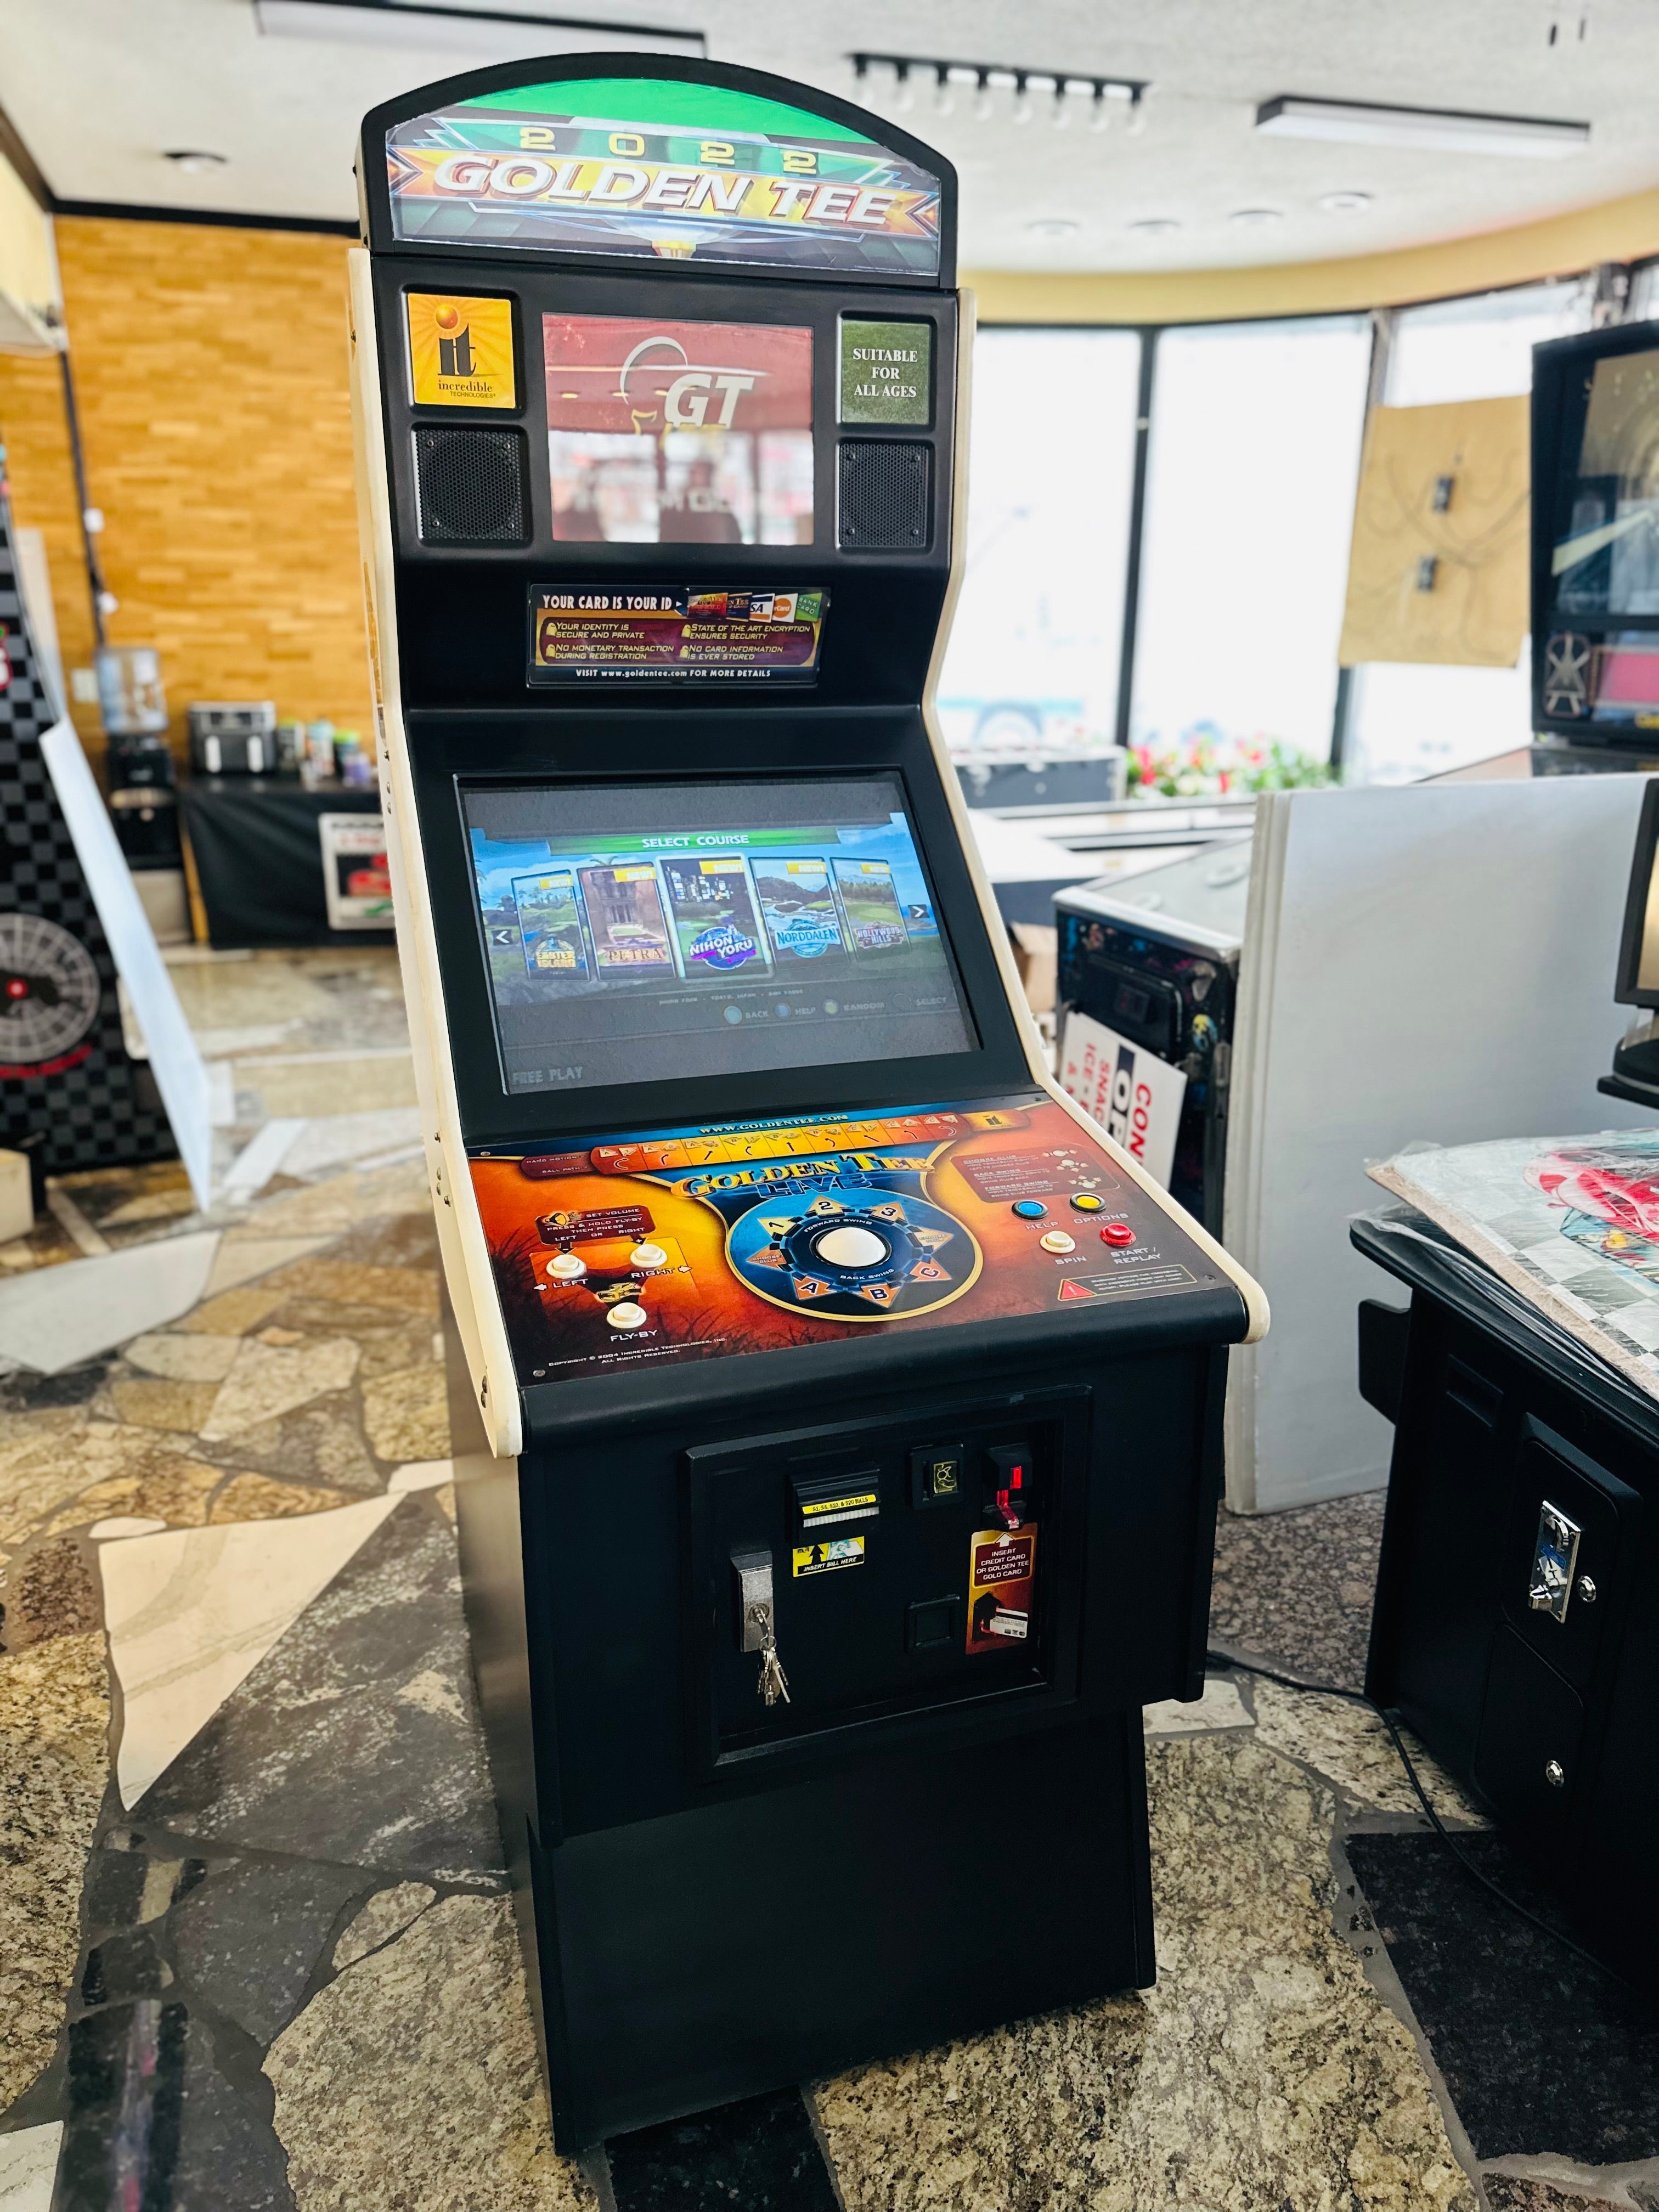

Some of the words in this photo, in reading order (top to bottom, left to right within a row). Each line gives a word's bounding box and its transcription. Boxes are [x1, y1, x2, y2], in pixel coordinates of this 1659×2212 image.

[435, 154, 753, 212] GOLDEN
[768, 180, 897, 225] TEE
[853, 348, 917, 363] SUITABLE
[872, 366, 899, 380] FOR
[439, 380, 493, 392] incredible
[854, 383, 878, 397] ALL
[882, 384, 916, 398] AGES
[664, 373, 755, 428] GT
[543, 595, 574, 609] YOUR
[578, 596, 608, 609] CARD
[613, 596, 622, 610] IS
[627, 596, 657, 610] YOUR
[661, 597, 672, 610] ID
[750, 603, 763, 613] SA
[799, 597, 818, 607] BANK
[797, 603, 816, 614] CARD
[556, 622, 579, 630] YOUR
[601, 669, 687, 678] www.goldentee.com
[641, 837, 690, 848] SELECT
[696, 835, 749, 845] COURSE
[777, 927, 838, 945] NORDDALEN
[857, 927, 900, 938] HOLLYWOOD
[690, 935, 732, 956] NIHON
[871, 935, 891, 944] HILLS
[717, 939, 753, 958] YORU
[608, 948, 664, 962] PETRA
[513, 1070, 543, 1084] FREE
[549, 1066, 582, 1081] PLAY
[1094, 1059, 1109, 1123] SNAC
[699, 1115, 849, 1133] WWW.GOLDENTEE.COM
[1130, 1083, 1152, 1159] CON
[670, 1159, 841, 1198] GOLDEN
[841, 1153, 935, 1172] TEE
[757, 1173, 873, 1198] LIVE
[819, 1200, 833, 1211] 2
[881, 1206, 896, 1217] 3
[1074, 1213, 1128, 1224] OPTIONS
[768, 1221, 785, 1229] 1
[804, 1218, 840, 1233] FORWARD
[1111, 1248, 1148, 1257] START
[1055, 1256, 1087, 1265] SPIN
[1114, 1254, 1161, 1265] REPLAY
[631, 1267, 675, 1278] RIGHT
[868, 1268, 895, 1279] SWING
[920, 1267, 939, 1278] C
[553, 1279, 588, 1288] LEFT
[800, 1282, 819, 1294] A
[870, 1288, 888, 1300] B
[611, 1330, 658, 1342] FLY-BY
[992, 1548, 1016, 1557] INSERT
[981, 1557, 1005, 1566] CREDIT
[988, 1562, 1015, 1572] GOLDEN
